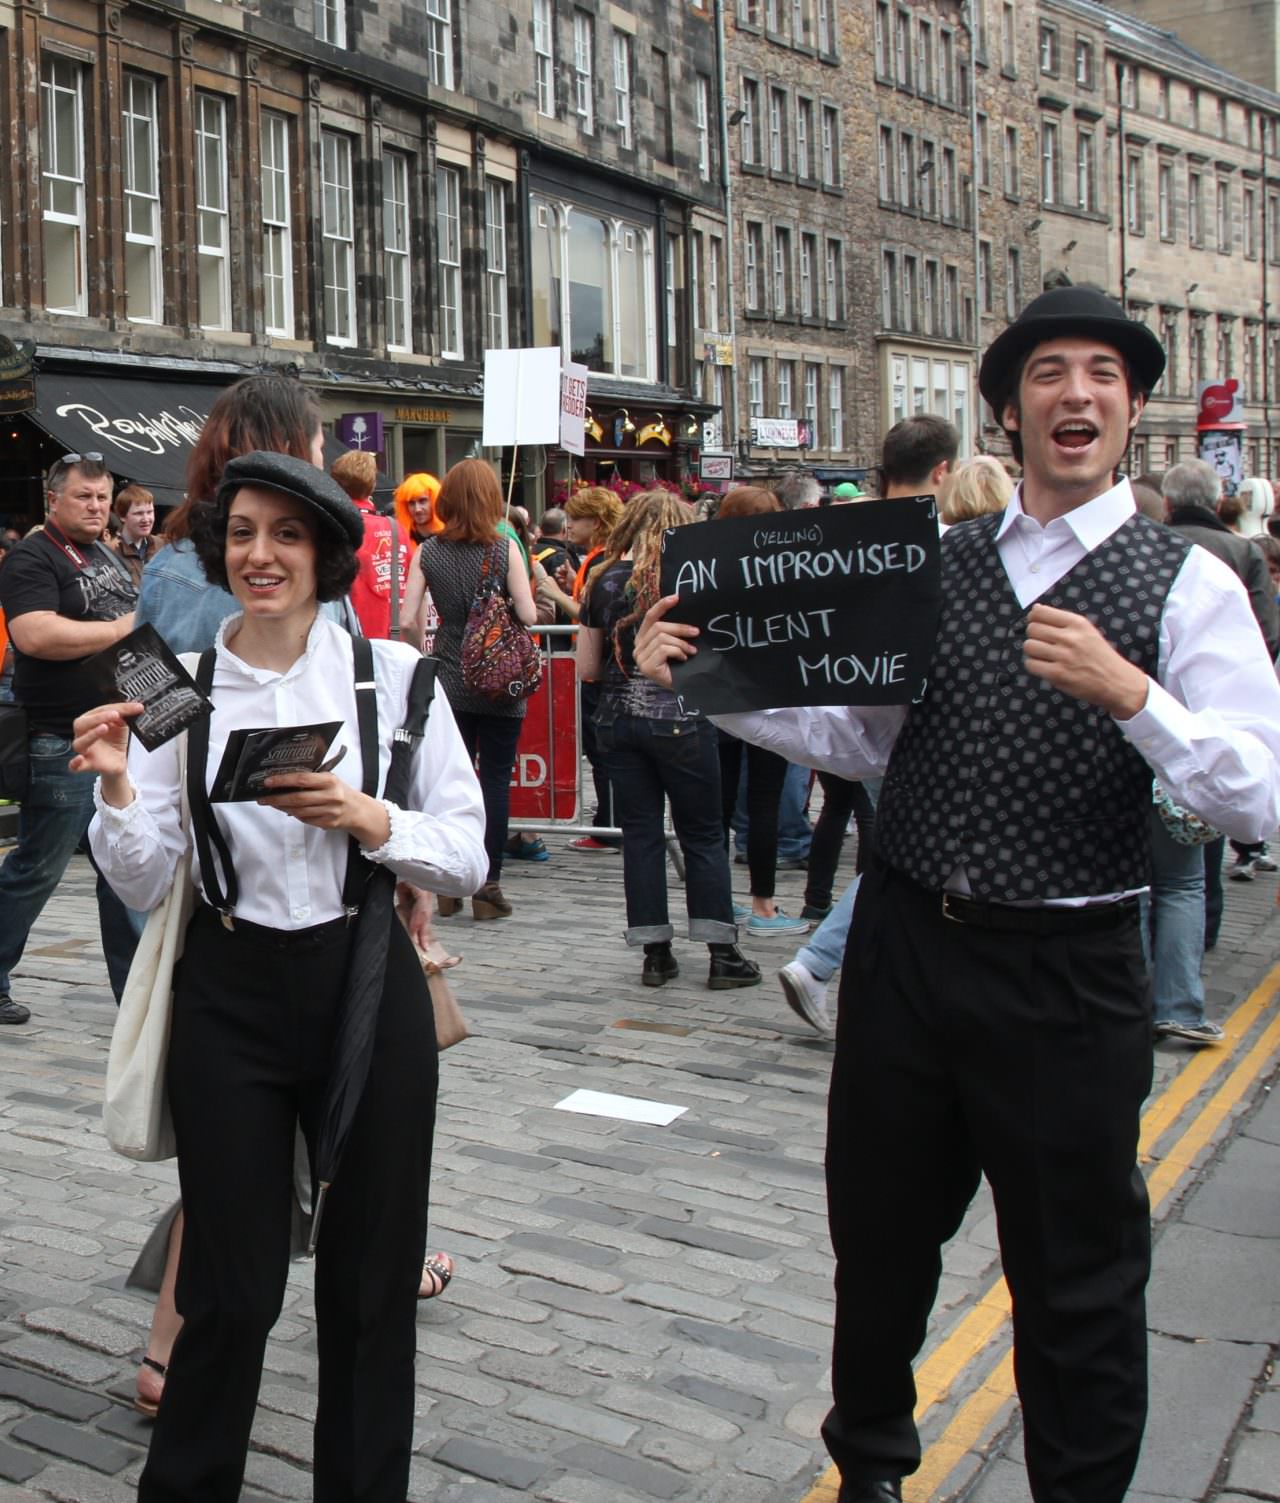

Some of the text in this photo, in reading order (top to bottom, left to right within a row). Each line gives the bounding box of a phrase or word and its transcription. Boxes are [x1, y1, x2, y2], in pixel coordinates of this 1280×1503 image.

[568, 377, 586, 399] GETS
[753, 524, 824, 549] (YELLING)
[675, 540, 926, 596] AN IMPROVISED
[707, 608, 837, 652] SILENT
[797, 650, 908, 687] MOVIE
